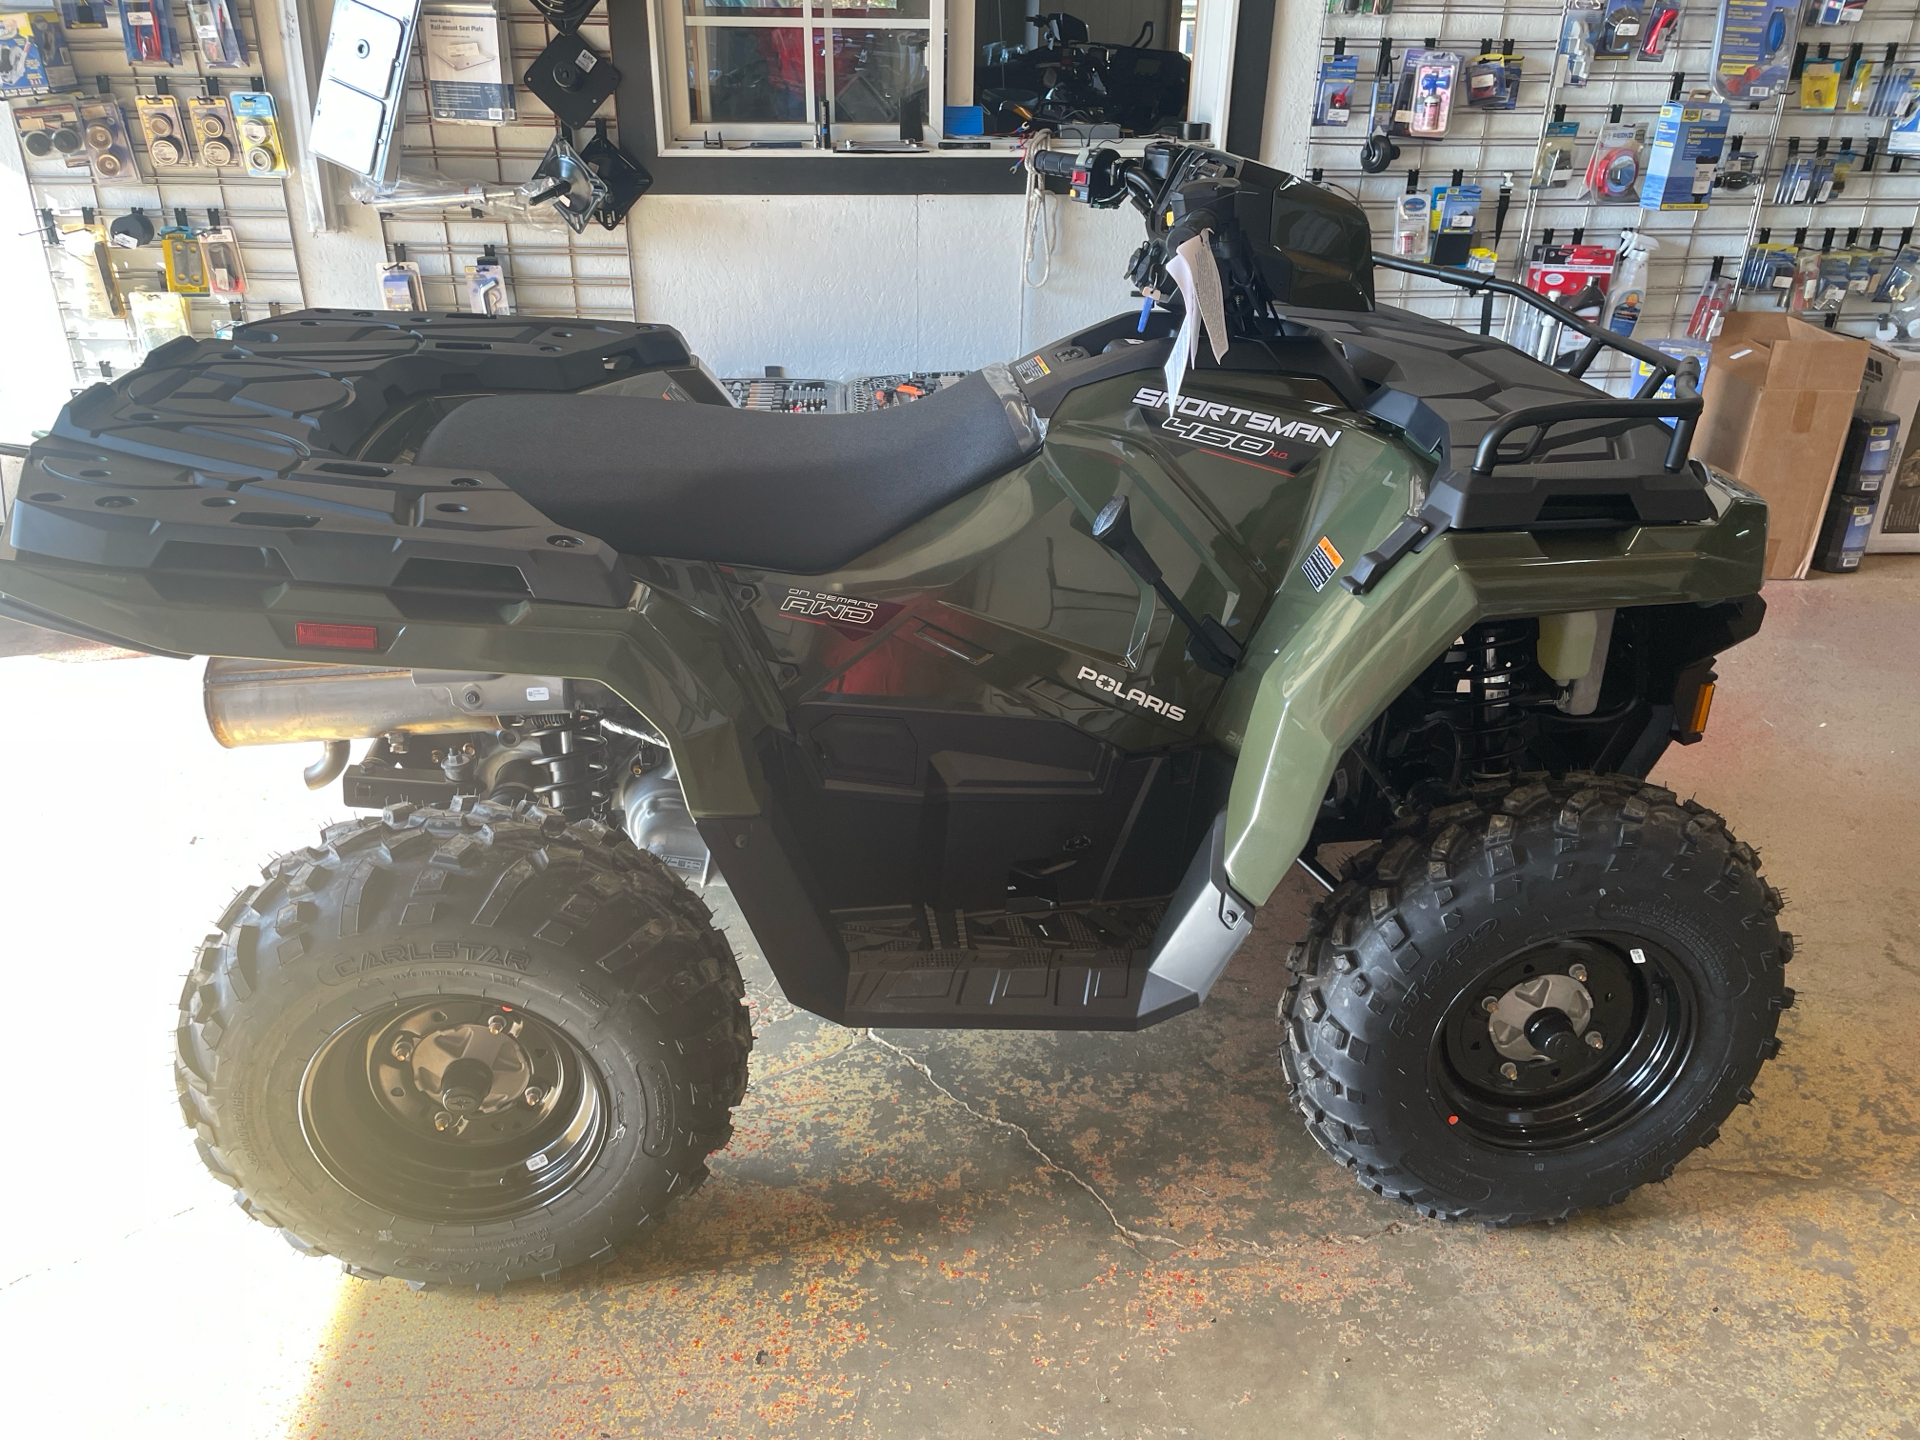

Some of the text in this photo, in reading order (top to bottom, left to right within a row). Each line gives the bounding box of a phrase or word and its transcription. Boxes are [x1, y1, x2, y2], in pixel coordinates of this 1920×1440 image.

[1132, 387, 1342, 448] SPORTSMAN
[1161, 416, 1275, 456] 450
[780, 595, 875, 625] AWD
[815, 593, 879, 609] DEMAND
[1076, 665, 1187, 722] POLARIS
[332, 940, 531, 979] CARLSTAR
